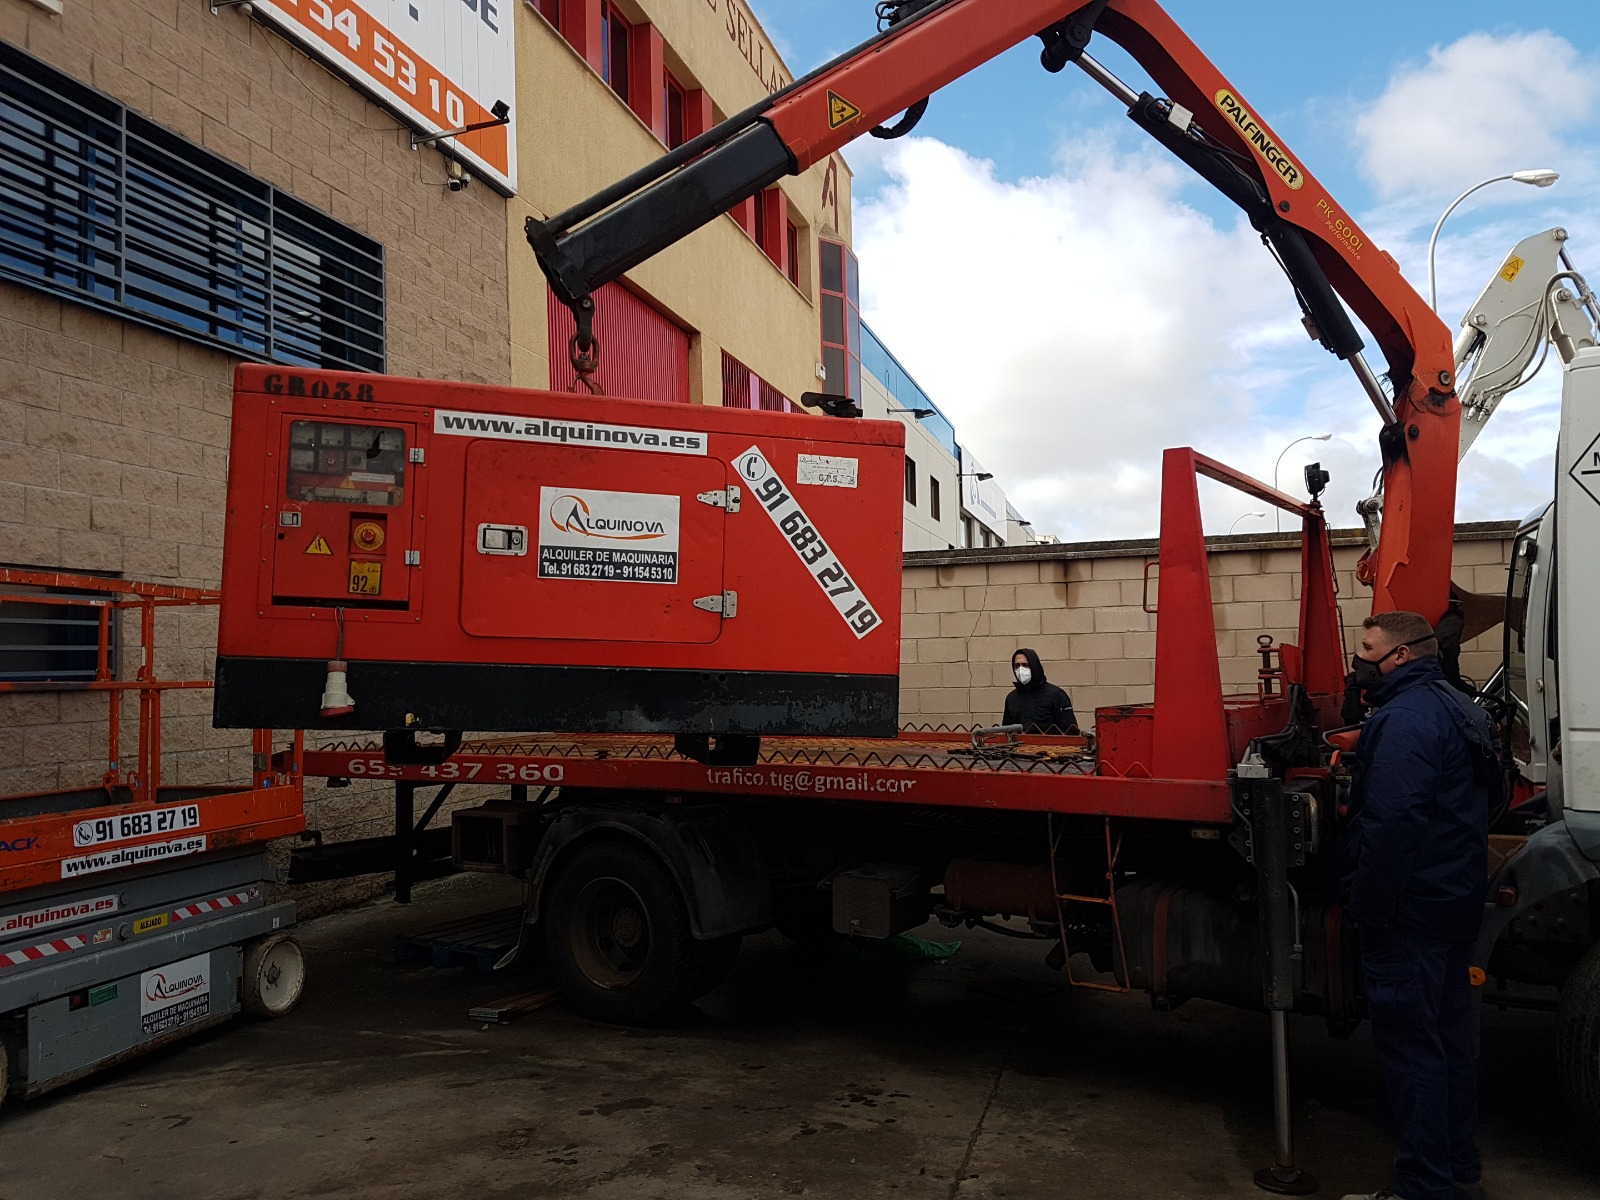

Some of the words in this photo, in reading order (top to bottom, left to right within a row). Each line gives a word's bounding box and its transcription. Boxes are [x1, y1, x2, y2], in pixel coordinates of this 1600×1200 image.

[373, 31, 417, 95] 53
[429, 78, 464, 128] 10
[1220, 94, 1299, 185] PALFINGER
[1317, 199, 1335, 219] PK
[442, 415, 701, 449] www.alquinova.es
[565, 503, 665, 534] ALQUINOVA
[542, 549, 593, 562] ALQUILER
[596, 551, 609, 562] DE
[612, 552, 675, 565] MAQUINARIA
[543, 562, 560, 575] Tel.
[755, 477, 790, 512] 91
[779, 510, 828, 565] 683
[817, 562, 855, 597] 27
[844, 599, 877, 634] 19
[352, 574, 368, 592] 92
[420, 763, 483, 779] 437
[496, 763, 564, 781] 360
[95, 819, 114, 842] 91
[120, 813, 152, 838] 683
[157, 809, 176, 831] 27
[181, 806, 198, 827] 19
[66, 838, 203, 873] www.alquinova.es
[154, 974, 204, 1000] ALQUINOVA
[143, 1009, 169, 1026] ALQUILER
[169, 1005, 177, 1015] DE
[177, 994, 209, 1013] MAQUINARIA
